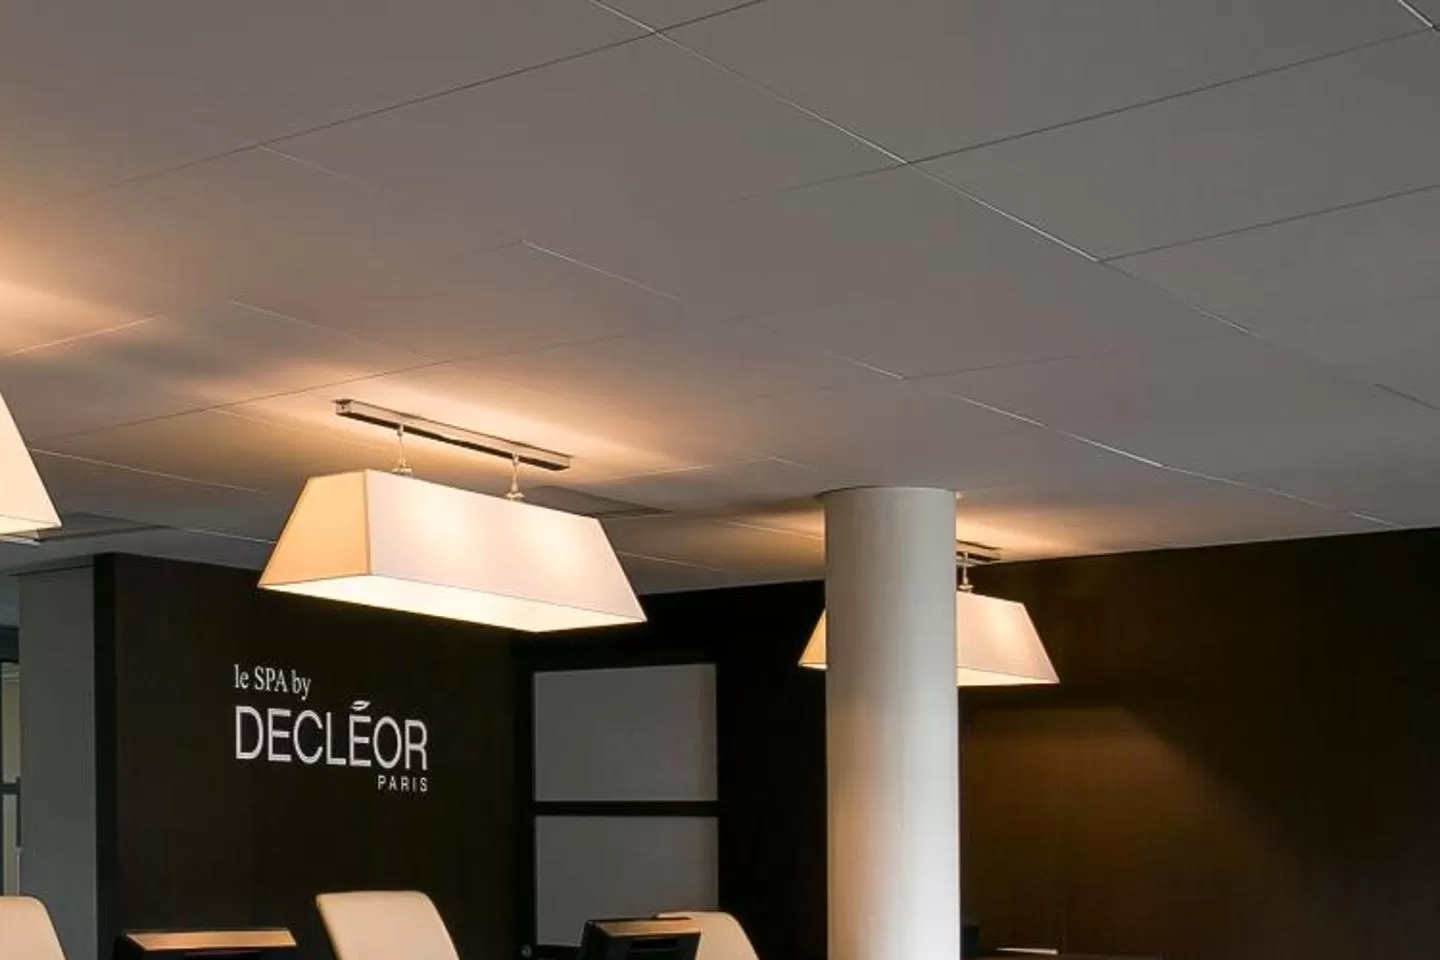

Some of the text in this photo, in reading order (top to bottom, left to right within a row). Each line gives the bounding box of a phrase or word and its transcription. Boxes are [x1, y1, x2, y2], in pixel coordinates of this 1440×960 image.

[234, 664, 311, 700] le SPA by
[235, 700, 427, 770] DECLÉOR
[377, 775, 428, 792] PARIS
